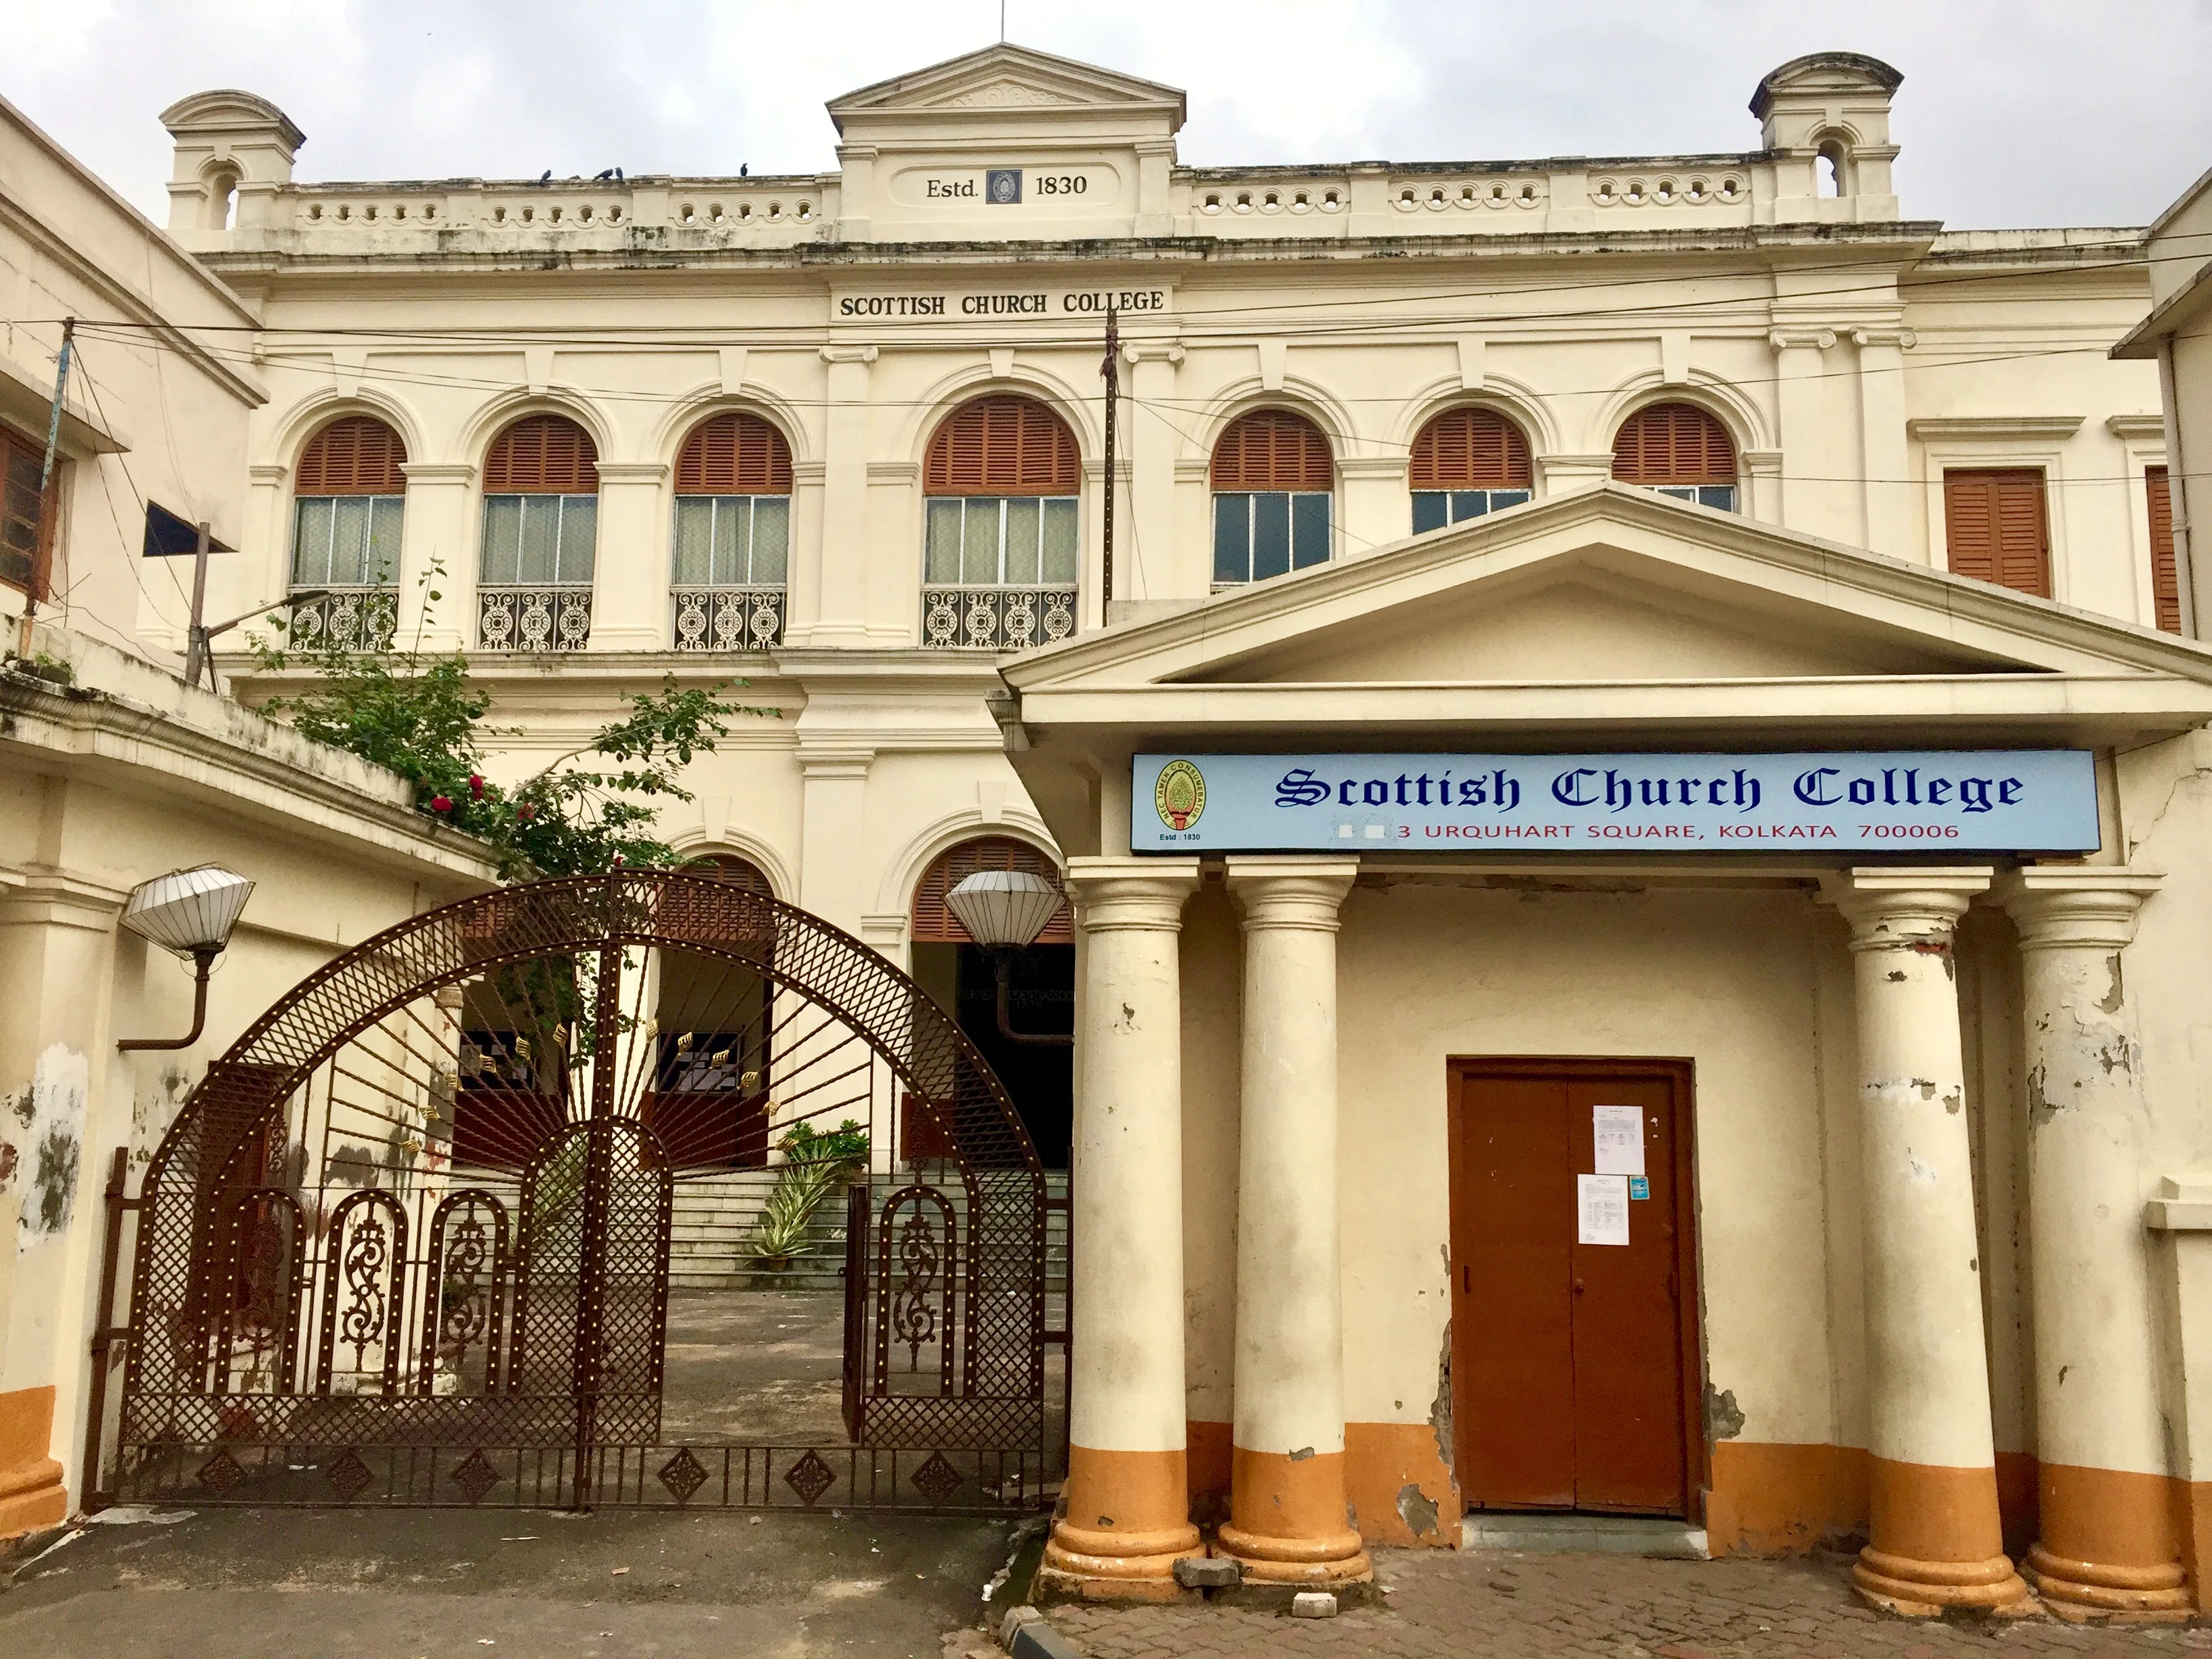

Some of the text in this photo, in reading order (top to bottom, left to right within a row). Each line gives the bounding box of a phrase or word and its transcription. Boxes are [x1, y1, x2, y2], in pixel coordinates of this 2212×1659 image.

[927, 180, 979, 199] Estd.
[1036, 176, 1088, 195] 1830
[840, 291, 1164, 316] SCOTTISH CHURCH COLLEGE
[1158, 762, 1204, 819] NEC TAMEN CONSUMEBATUR
[1274, 768, 2024, 813] Scottish Church College
[1397, 825, 1960, 841] 3 URQUHART SQUARE, KOLKATA 700006
